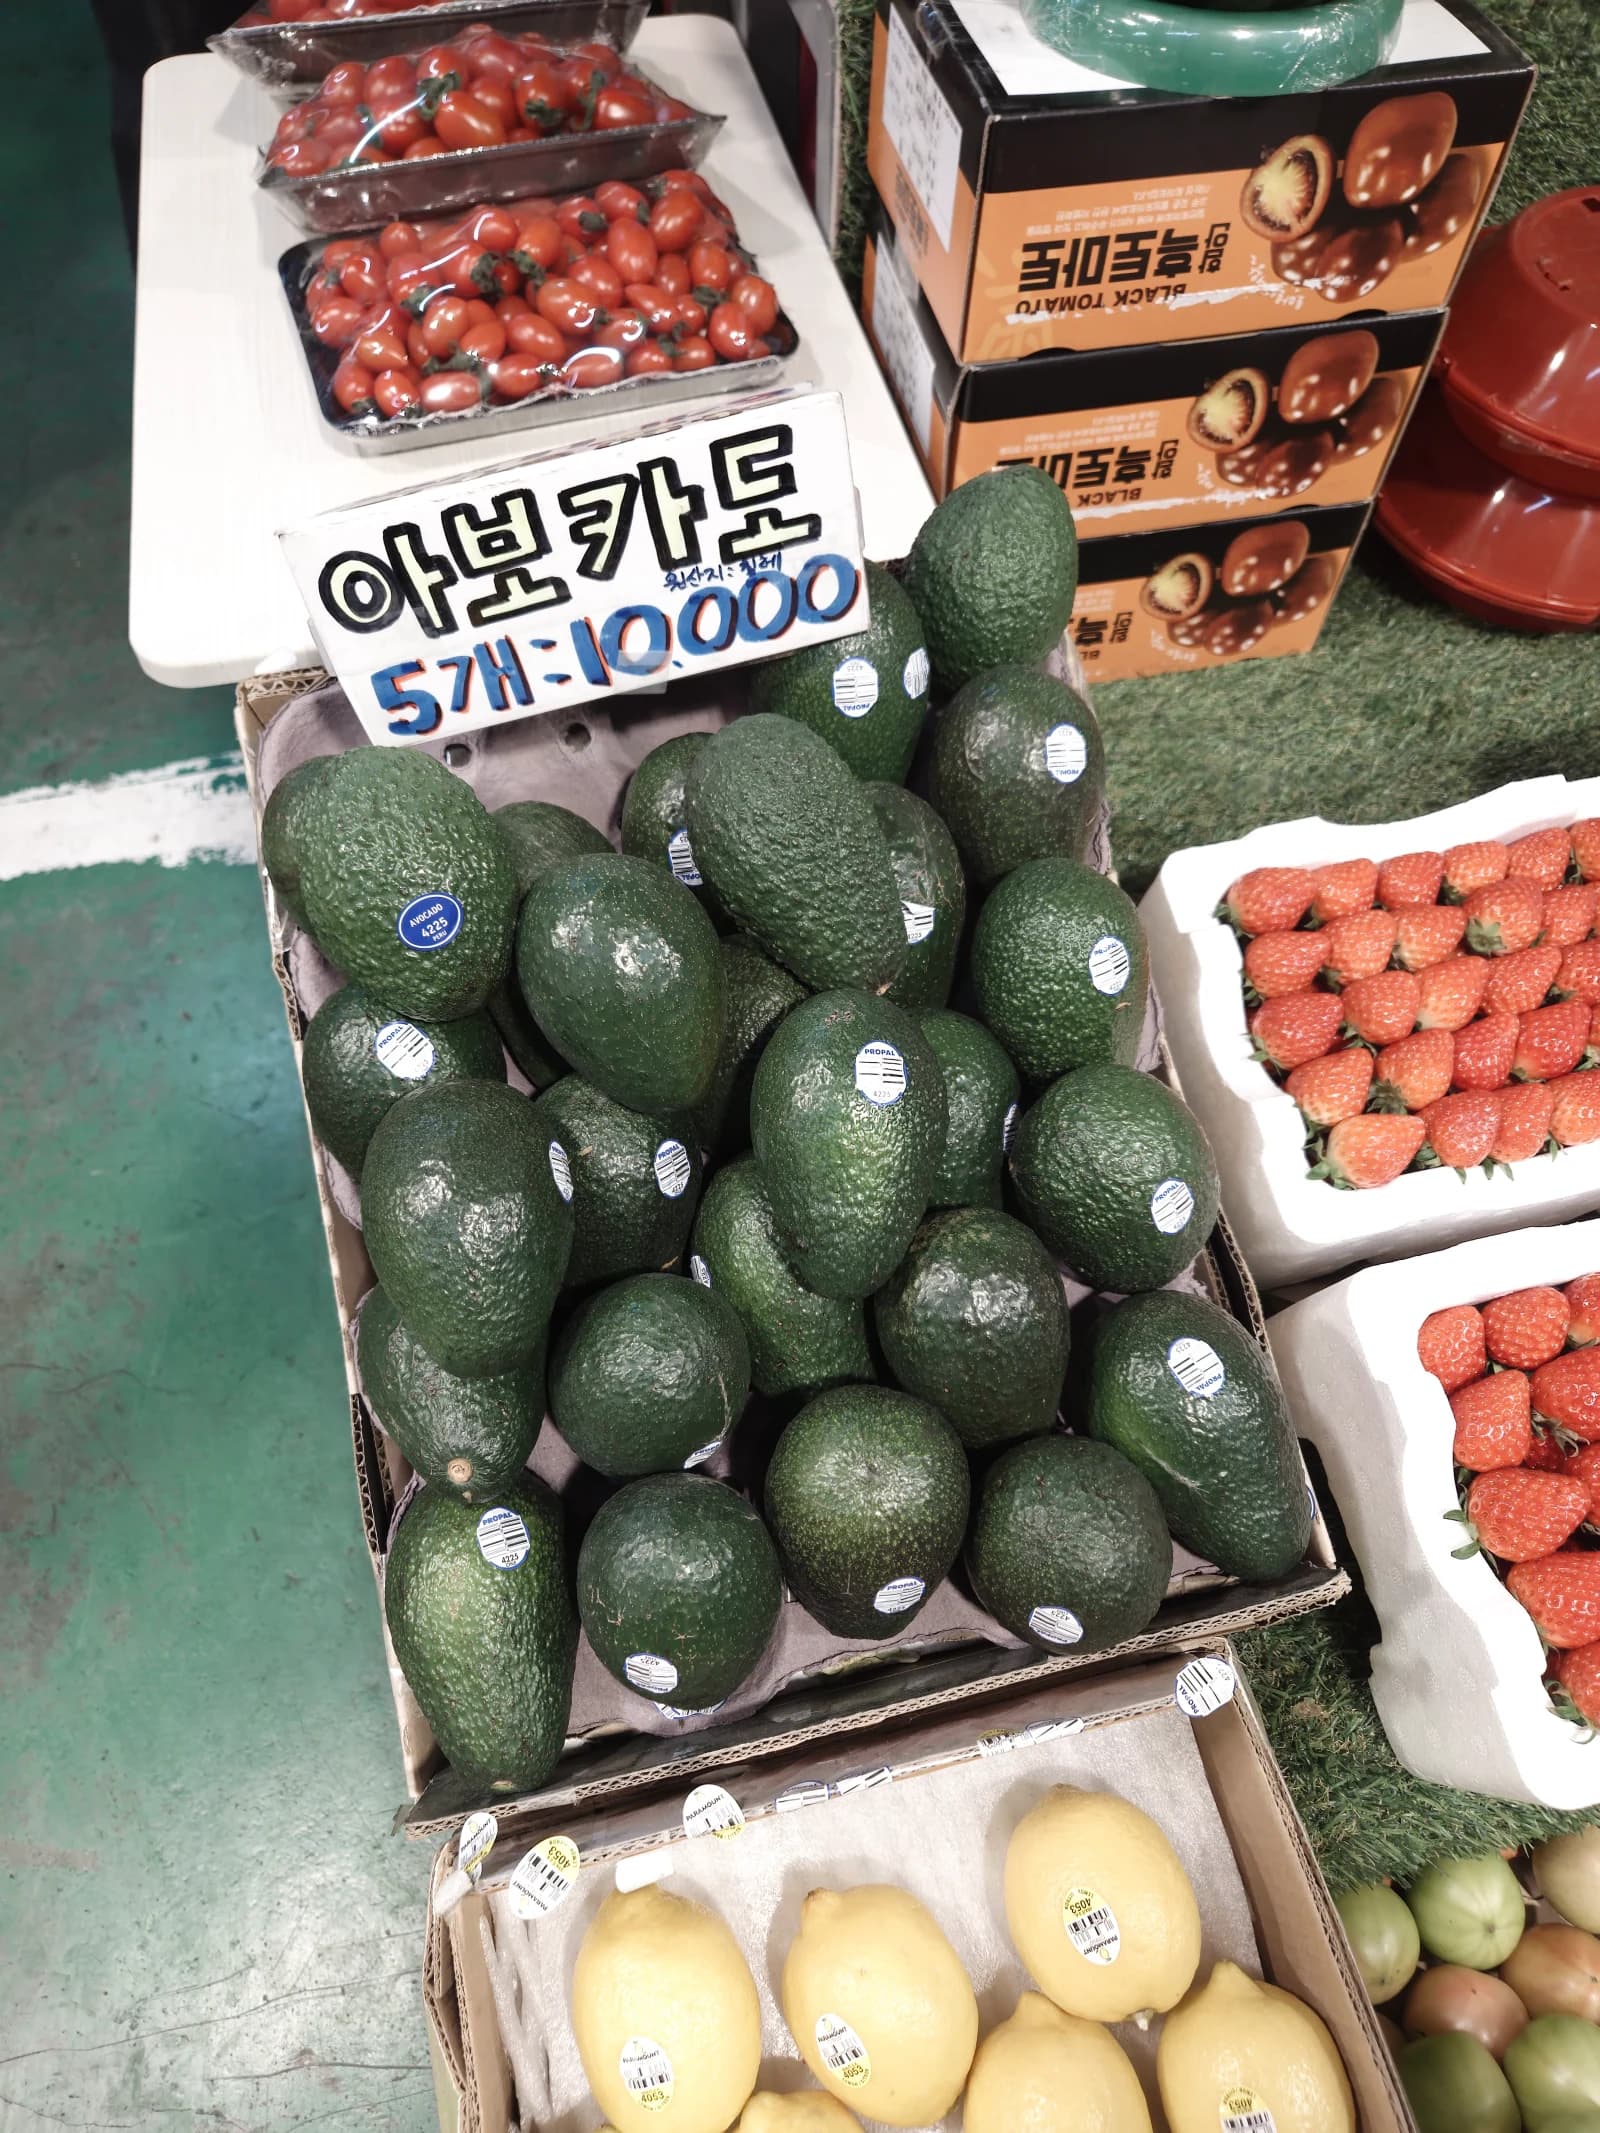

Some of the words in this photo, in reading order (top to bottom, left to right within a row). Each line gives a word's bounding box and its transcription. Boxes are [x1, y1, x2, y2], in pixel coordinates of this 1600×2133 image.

[1018, 229, 1201, 293] 흑토마토
[1015, 291, 1105, 315] TOMATO
[1113, 283, 1187, 307] BLACK
[997, 445, 1151, 490] 흑토마
[1078, 487, 1142, 507] BLACK
[318, 424, 822, 638] 아보카도
[409, 903, 443, 928] AVOCADO
[421, 917, 449, 938] 4225
[378, 1026, 404, 1048] PROPAL
[864, 1048, 895, 1056] PROPAL
[658, 1144, 680, 1159] PROPAL
[1155, 1183, 1179, 1202] PROPAL
[1196, 1374, 1222, 1390] PROPAL
[483, 1512, 513, 1525] PROPAL
[502, 1553, 519, 1564] 4225
[887, 1581, 917, 1590] PROPAL
[1177, 1685, 1199, 1714] PROPAL
[686, 1794, 724, 1821] PARAMOUNT
[461, 1818, 491, 1852] PARAMOUNT
[548, 1846, 571, 1869] 4053
[513, 1880, 548, 1911] PARAMOUNT
[1070, 1897, 1091, 1914] 4053
[1084, 1935, 1118, 1955] PARAMOUNT
[843, 2065, 864, 2079] 4053
[641, 2090, 665, 2103] 4053
